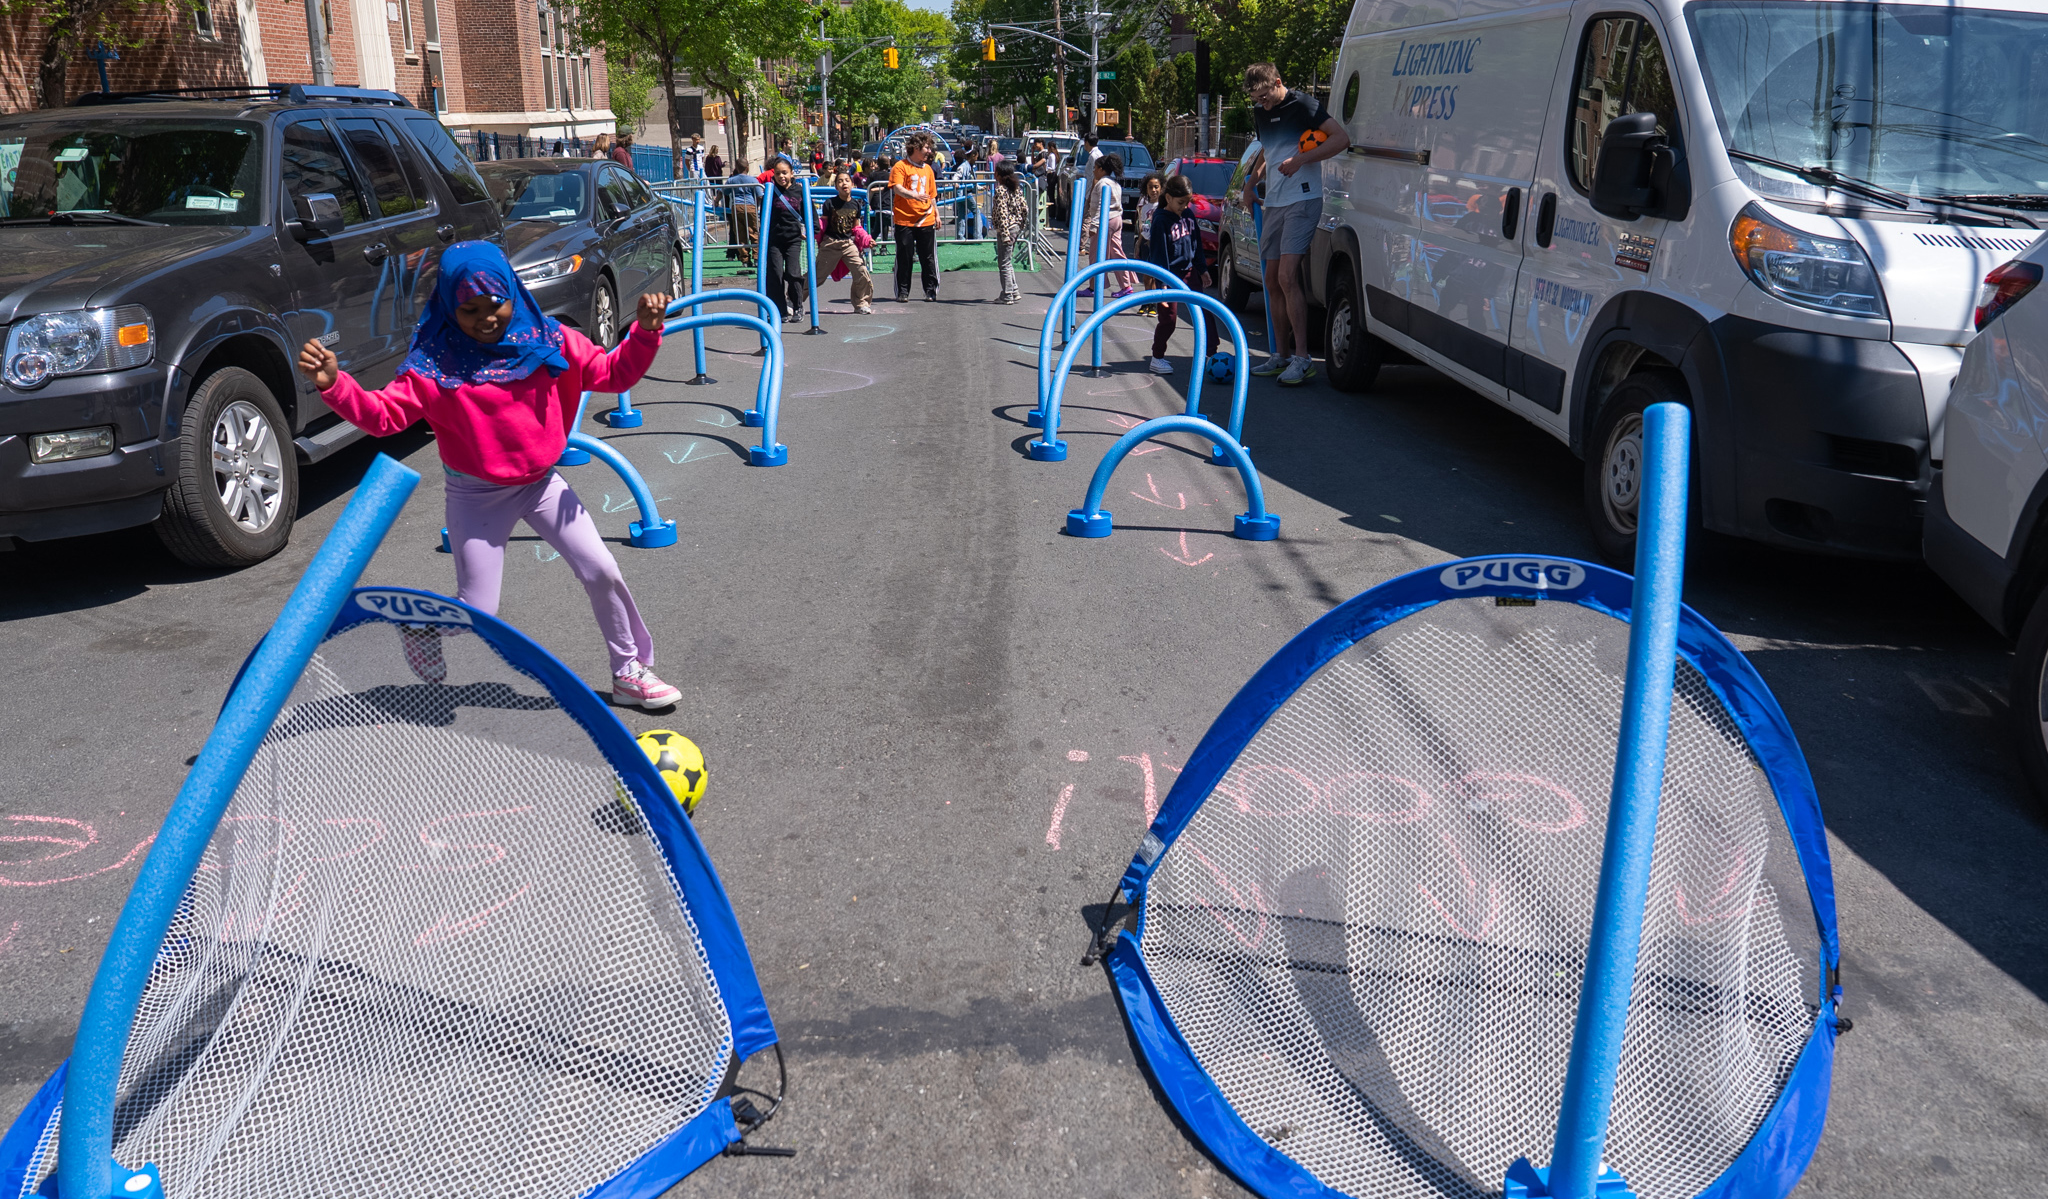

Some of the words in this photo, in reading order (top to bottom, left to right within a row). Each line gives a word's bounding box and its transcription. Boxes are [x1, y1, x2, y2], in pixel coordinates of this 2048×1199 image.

[1620, 232, 1657, 248] RAM
[1617, 243, 1653, 260] 2500
[1455, 561, 1571, 587] PUGG
[365, 594, 463, 620] PUGG
